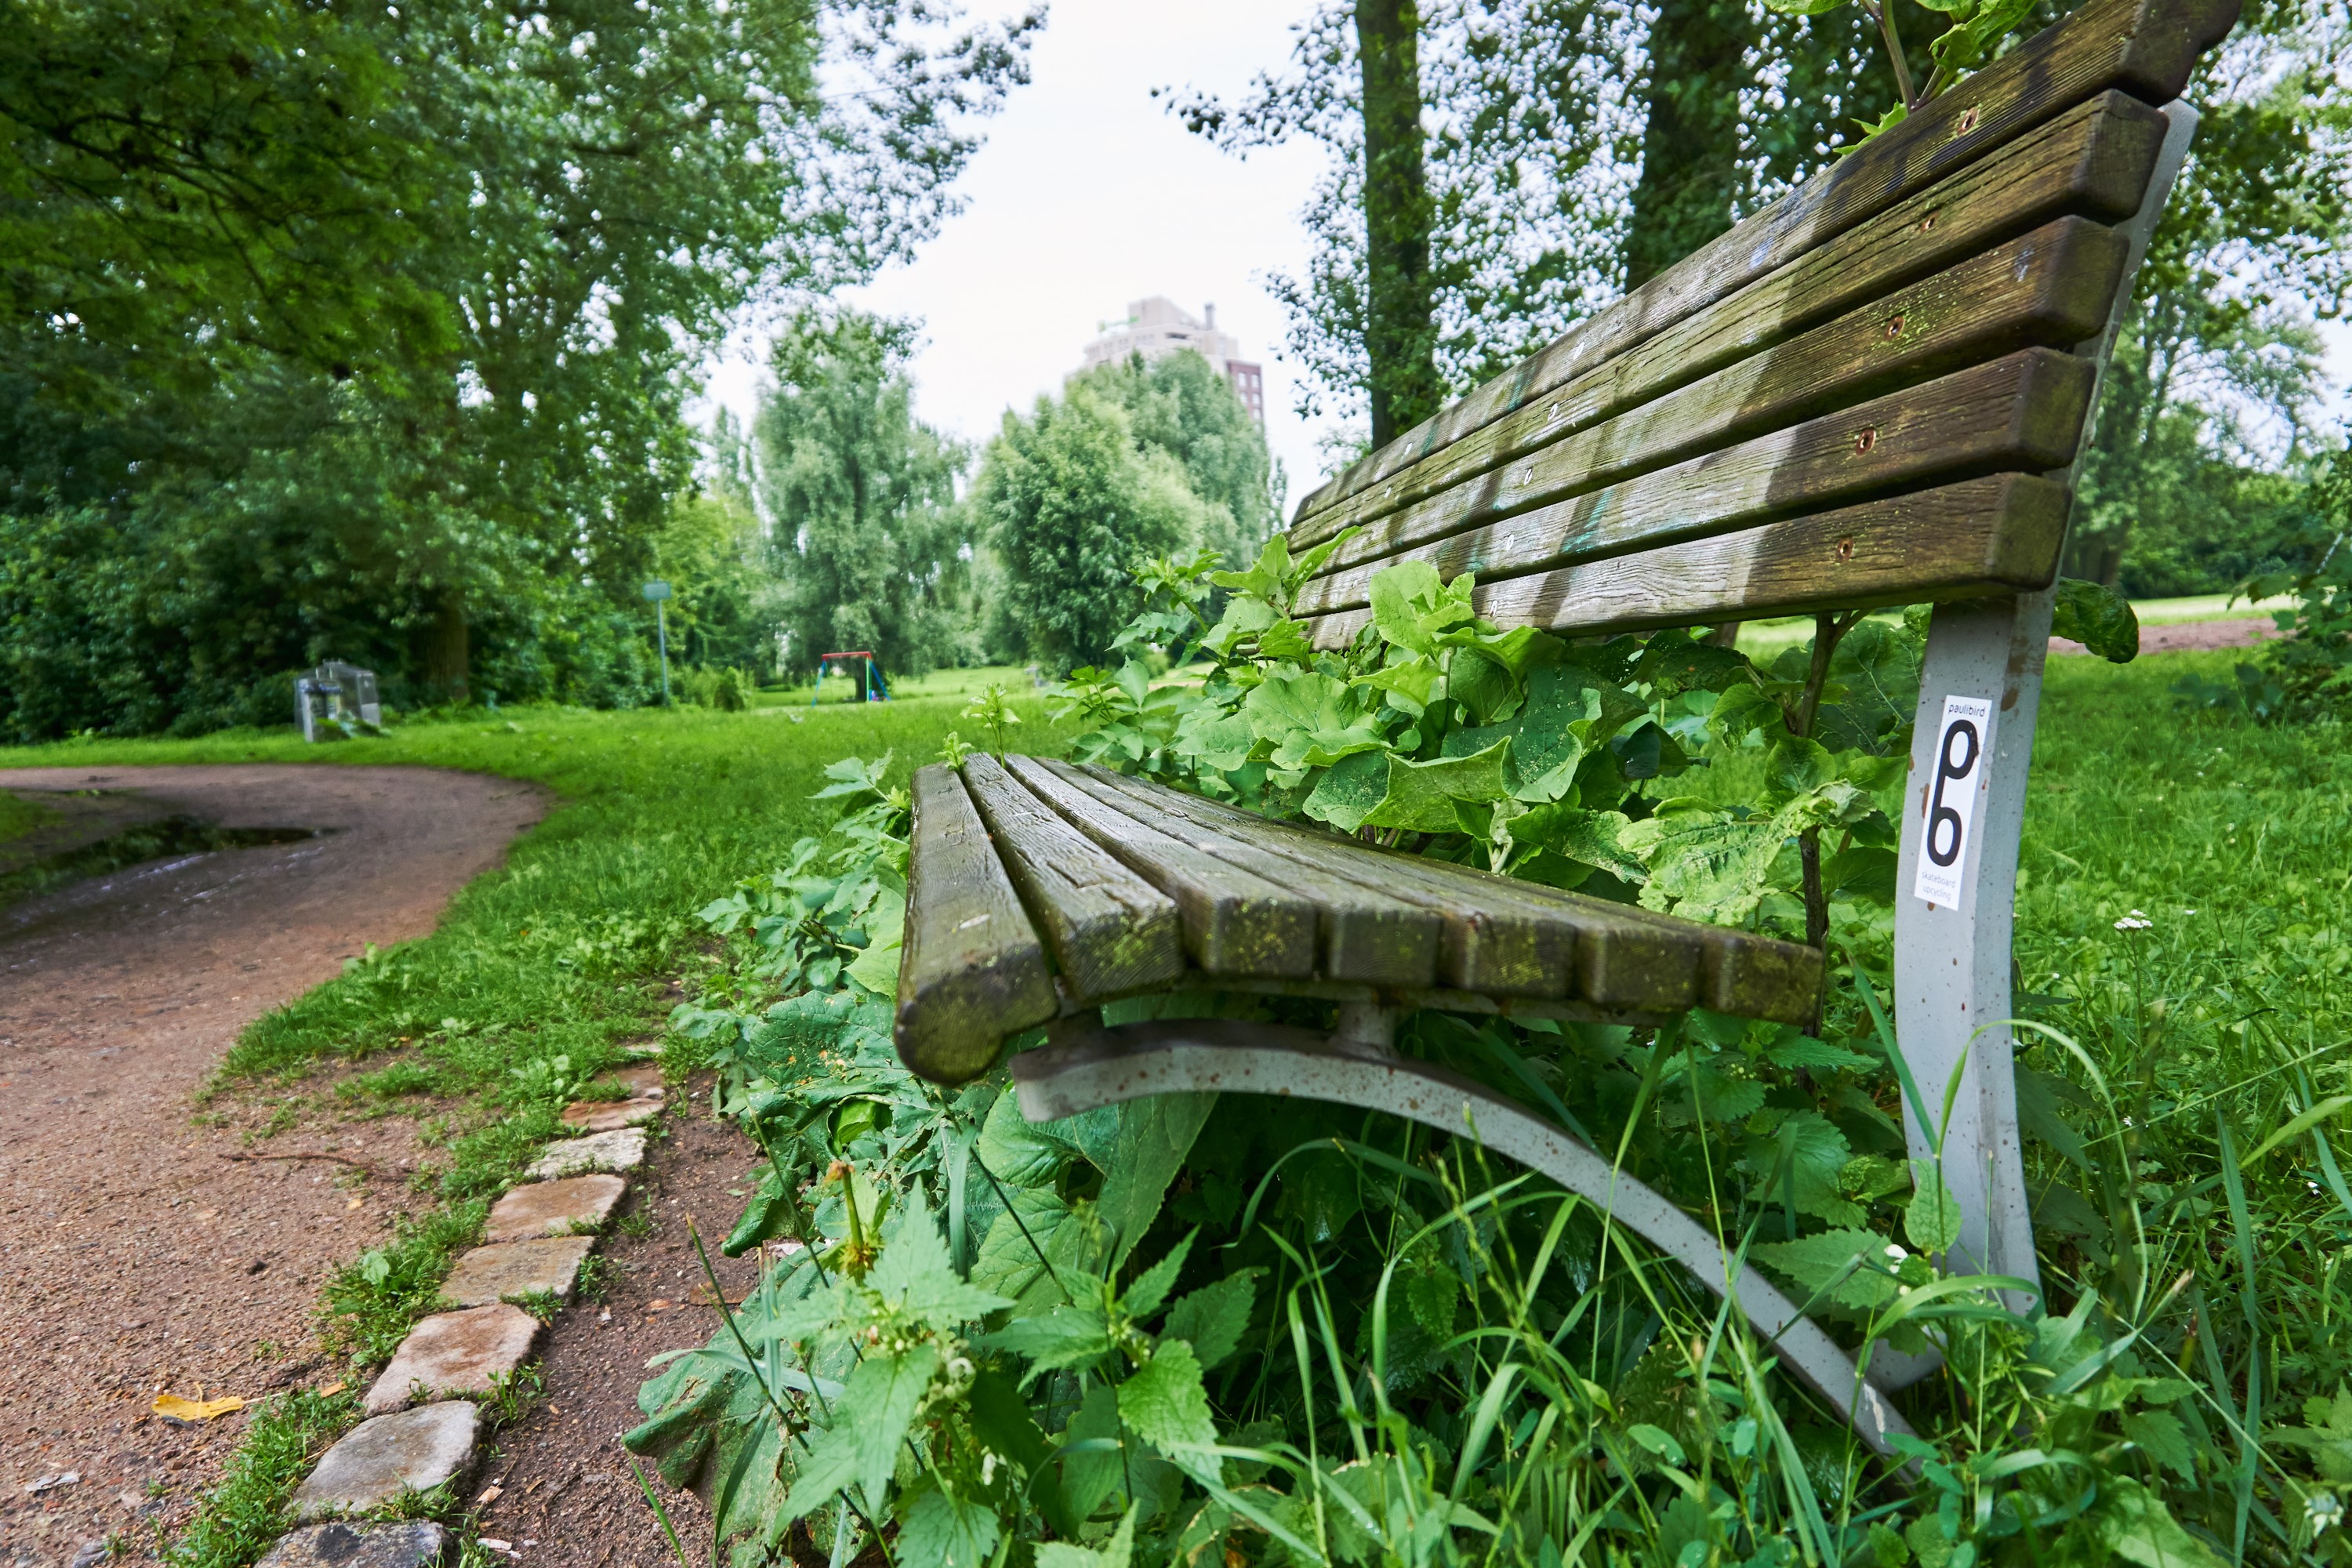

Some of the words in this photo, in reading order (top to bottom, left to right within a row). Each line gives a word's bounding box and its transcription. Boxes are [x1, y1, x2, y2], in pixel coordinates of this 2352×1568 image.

[1948, 704, 1986, 717] paulibird
[1921, 870, 1956, 888] skateboard
[1922, 885, 1951, 902] upcycling
